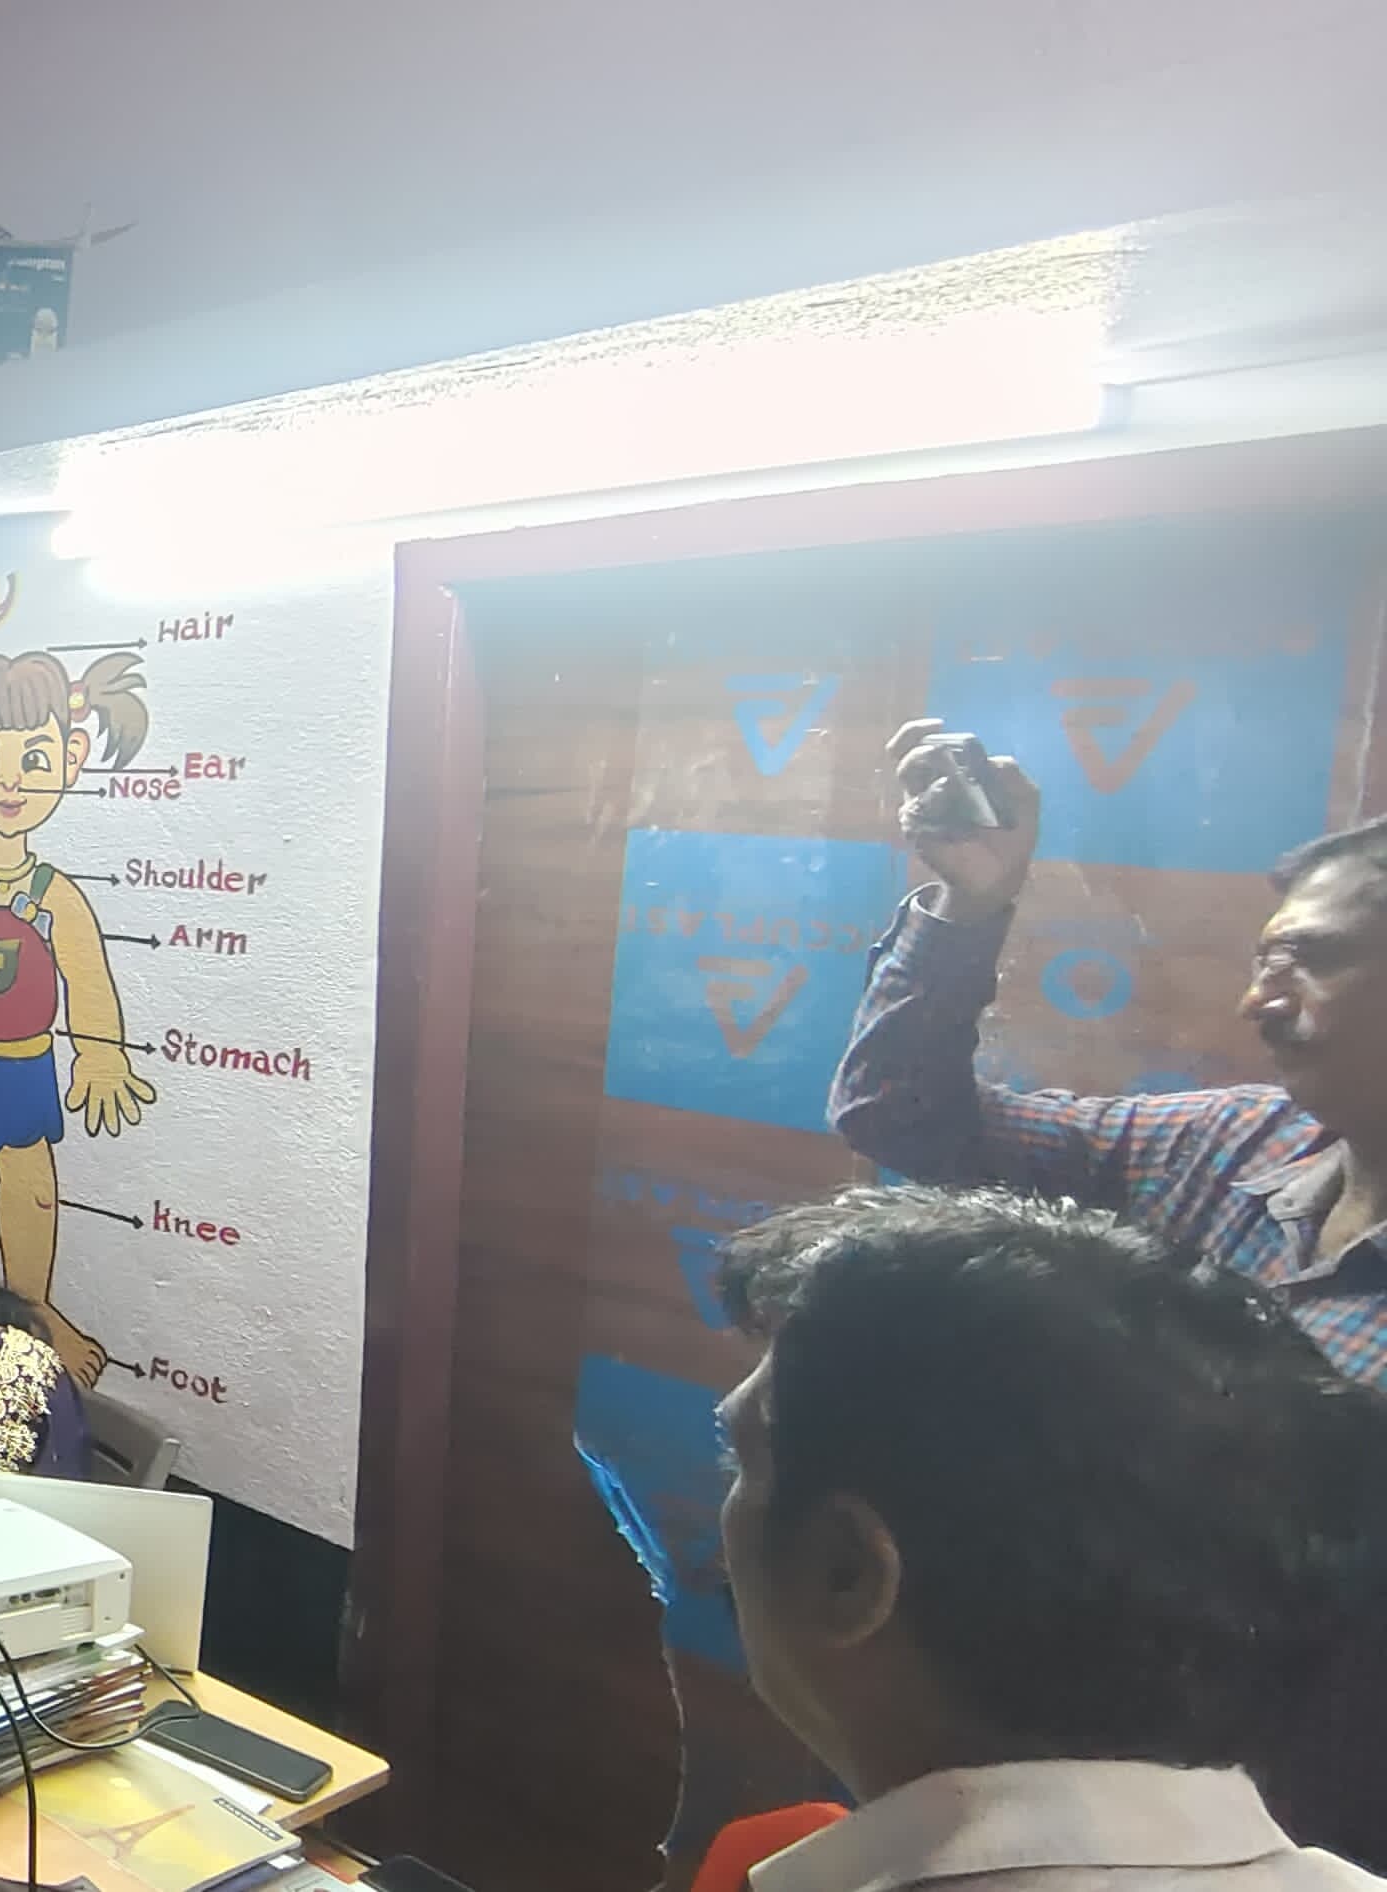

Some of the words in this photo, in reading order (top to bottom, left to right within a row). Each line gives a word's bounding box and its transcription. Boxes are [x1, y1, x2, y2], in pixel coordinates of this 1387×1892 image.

[157, 610, 234, 643] Hair
[183, 751, 246, 781] Ear
[108, 775, 182, 800] Nose
[125, 858, 267, 893] Shoulder
[168, 925, 249, 954] Arm
[161, 1029, 312, 1081] Stomach
[149, 1357, 229, 1403] Foot
